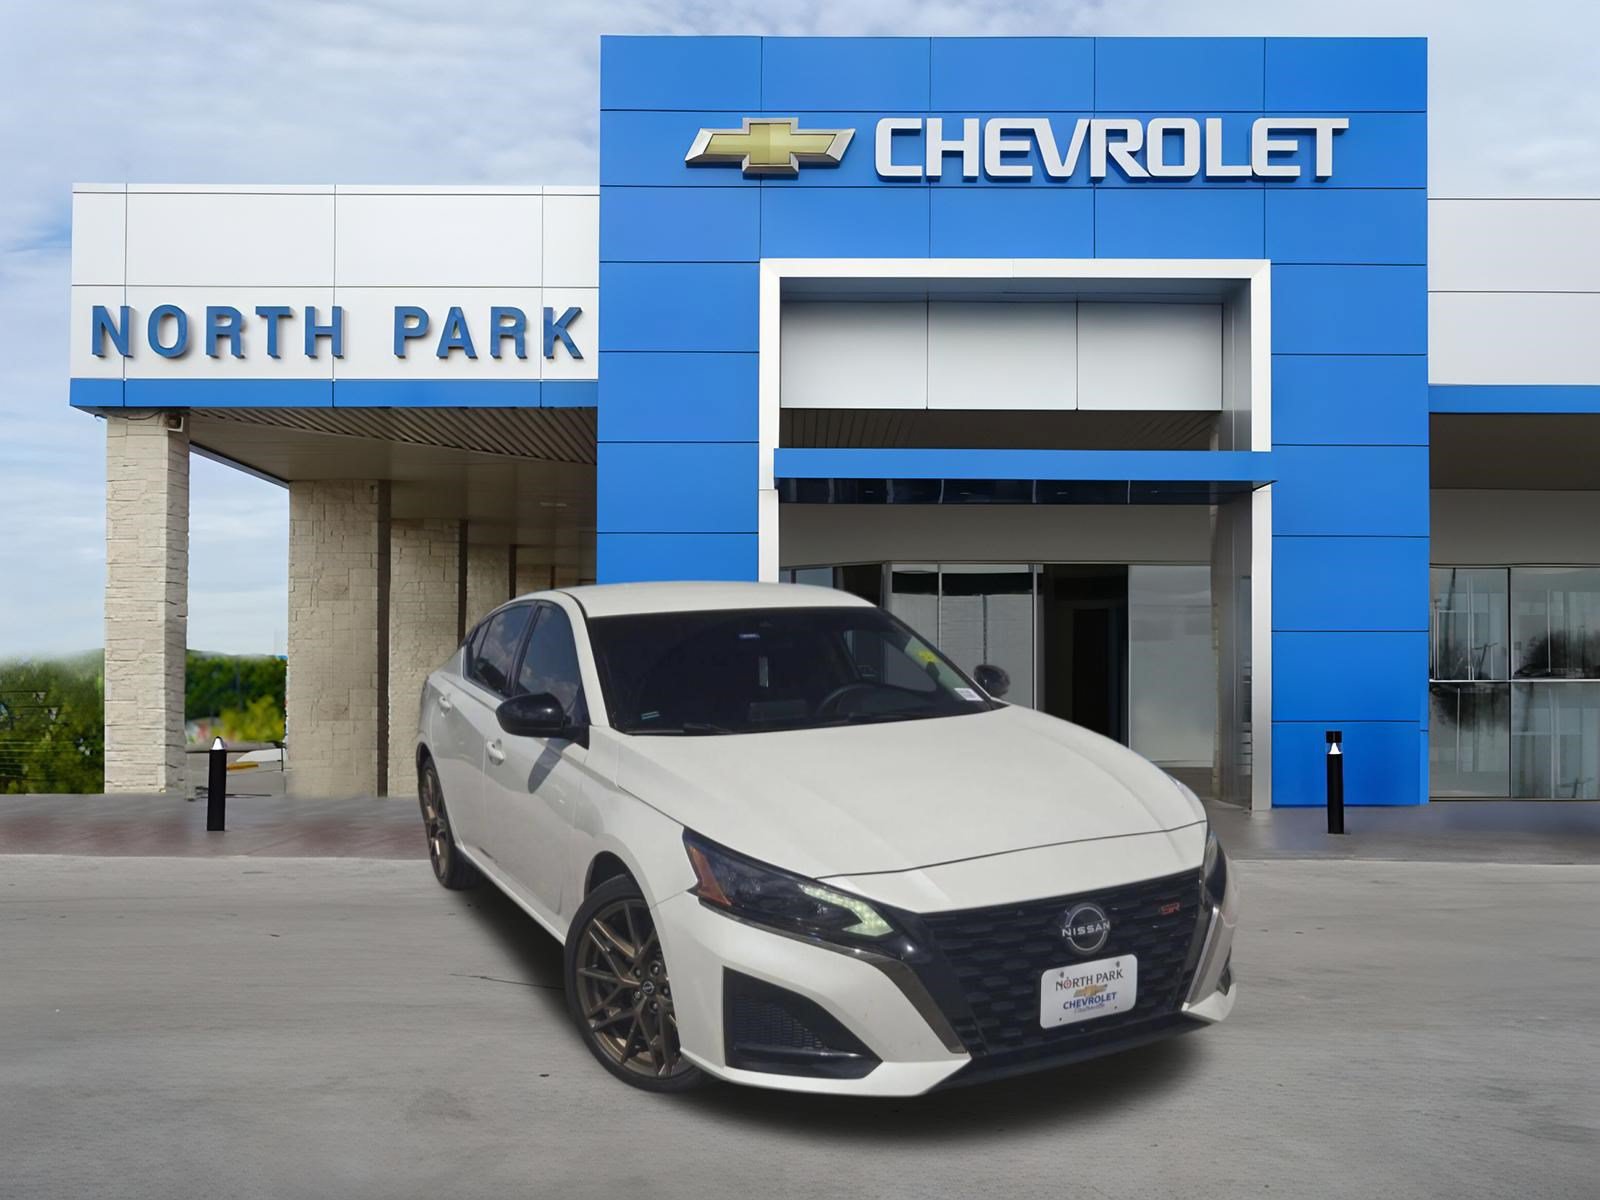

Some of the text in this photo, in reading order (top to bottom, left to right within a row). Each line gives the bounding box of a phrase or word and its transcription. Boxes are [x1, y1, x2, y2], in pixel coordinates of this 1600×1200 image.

[875, 117, 1350, 181] CHEVROLET
[91, 304, 585, 360] NORTH PARK
[1062, 920, 1111, 937] NISSAN
[1055, 968, 1124, 991] NORTH PARK
[1063, 992, 1117, 1010] CHEVROLET
